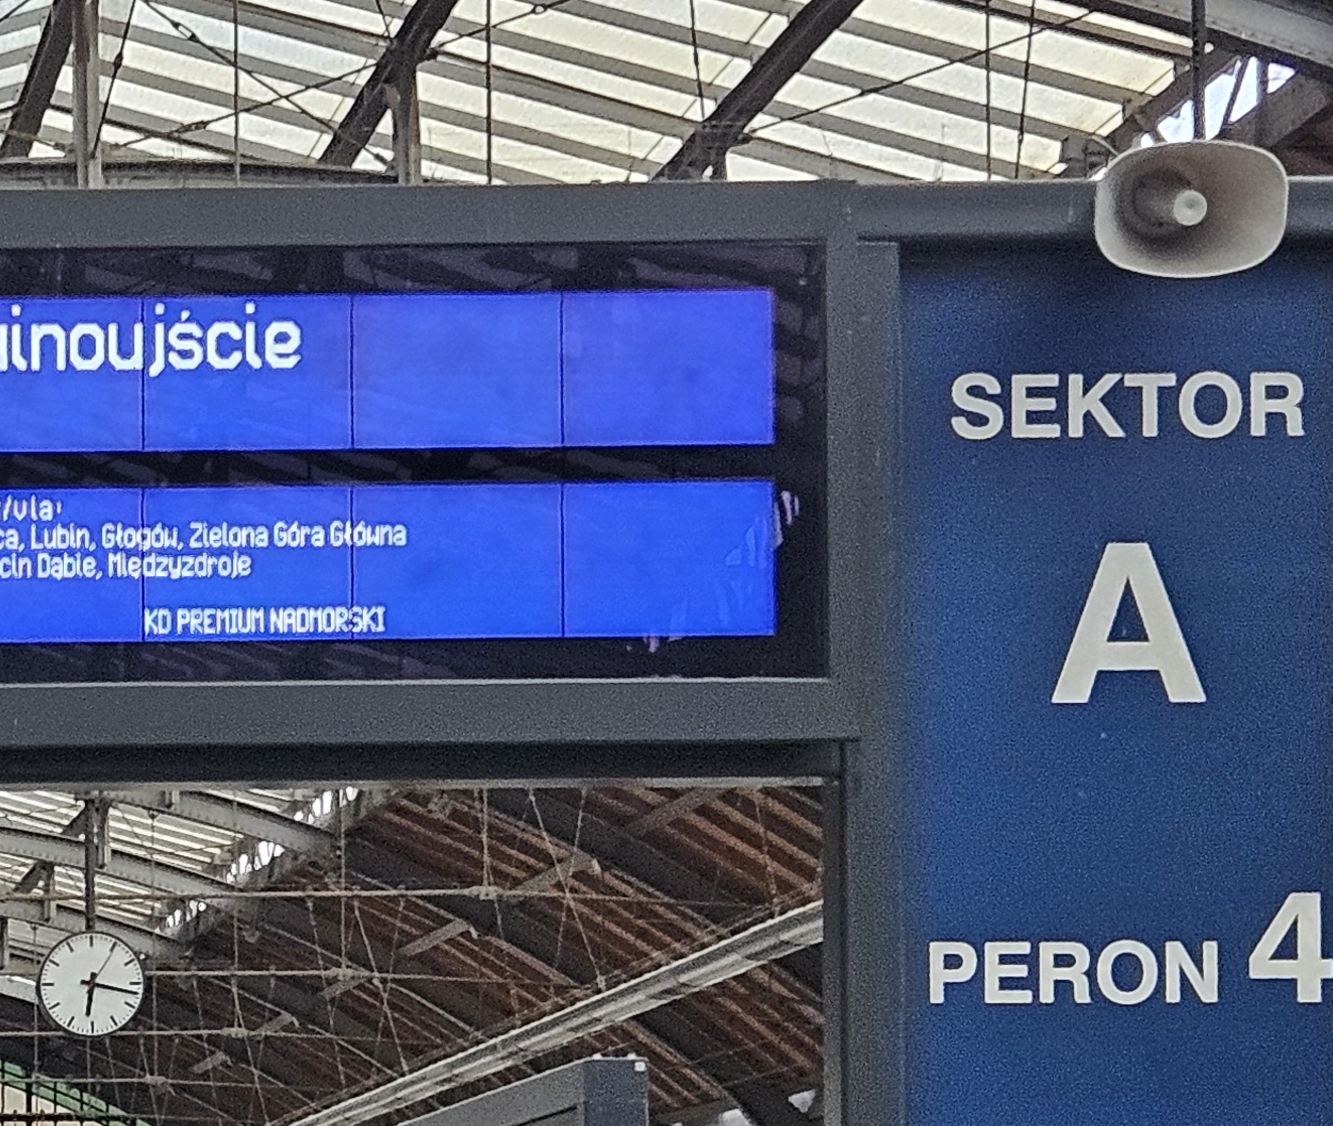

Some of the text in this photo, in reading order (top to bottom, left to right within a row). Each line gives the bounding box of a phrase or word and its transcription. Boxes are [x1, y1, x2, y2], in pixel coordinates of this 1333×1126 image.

[952, 371, 1305, 440] SEKTOR
[31, 523, 96, 551] Lubin,
[102, 522, 183, 551] Głogów,
[189, 521, 269, 548] Zielona
[274, 521, 325, 547] Góra
[330, 520, 407, 547] Główna
[108, 551, 252, 580] Międzyzdroje
[144, 605, 386, 634] KD PREMIUM NADMORSKI
[1052, 543, 1206, 704] A
[929, 891, 1333, 1004] PERON 4
